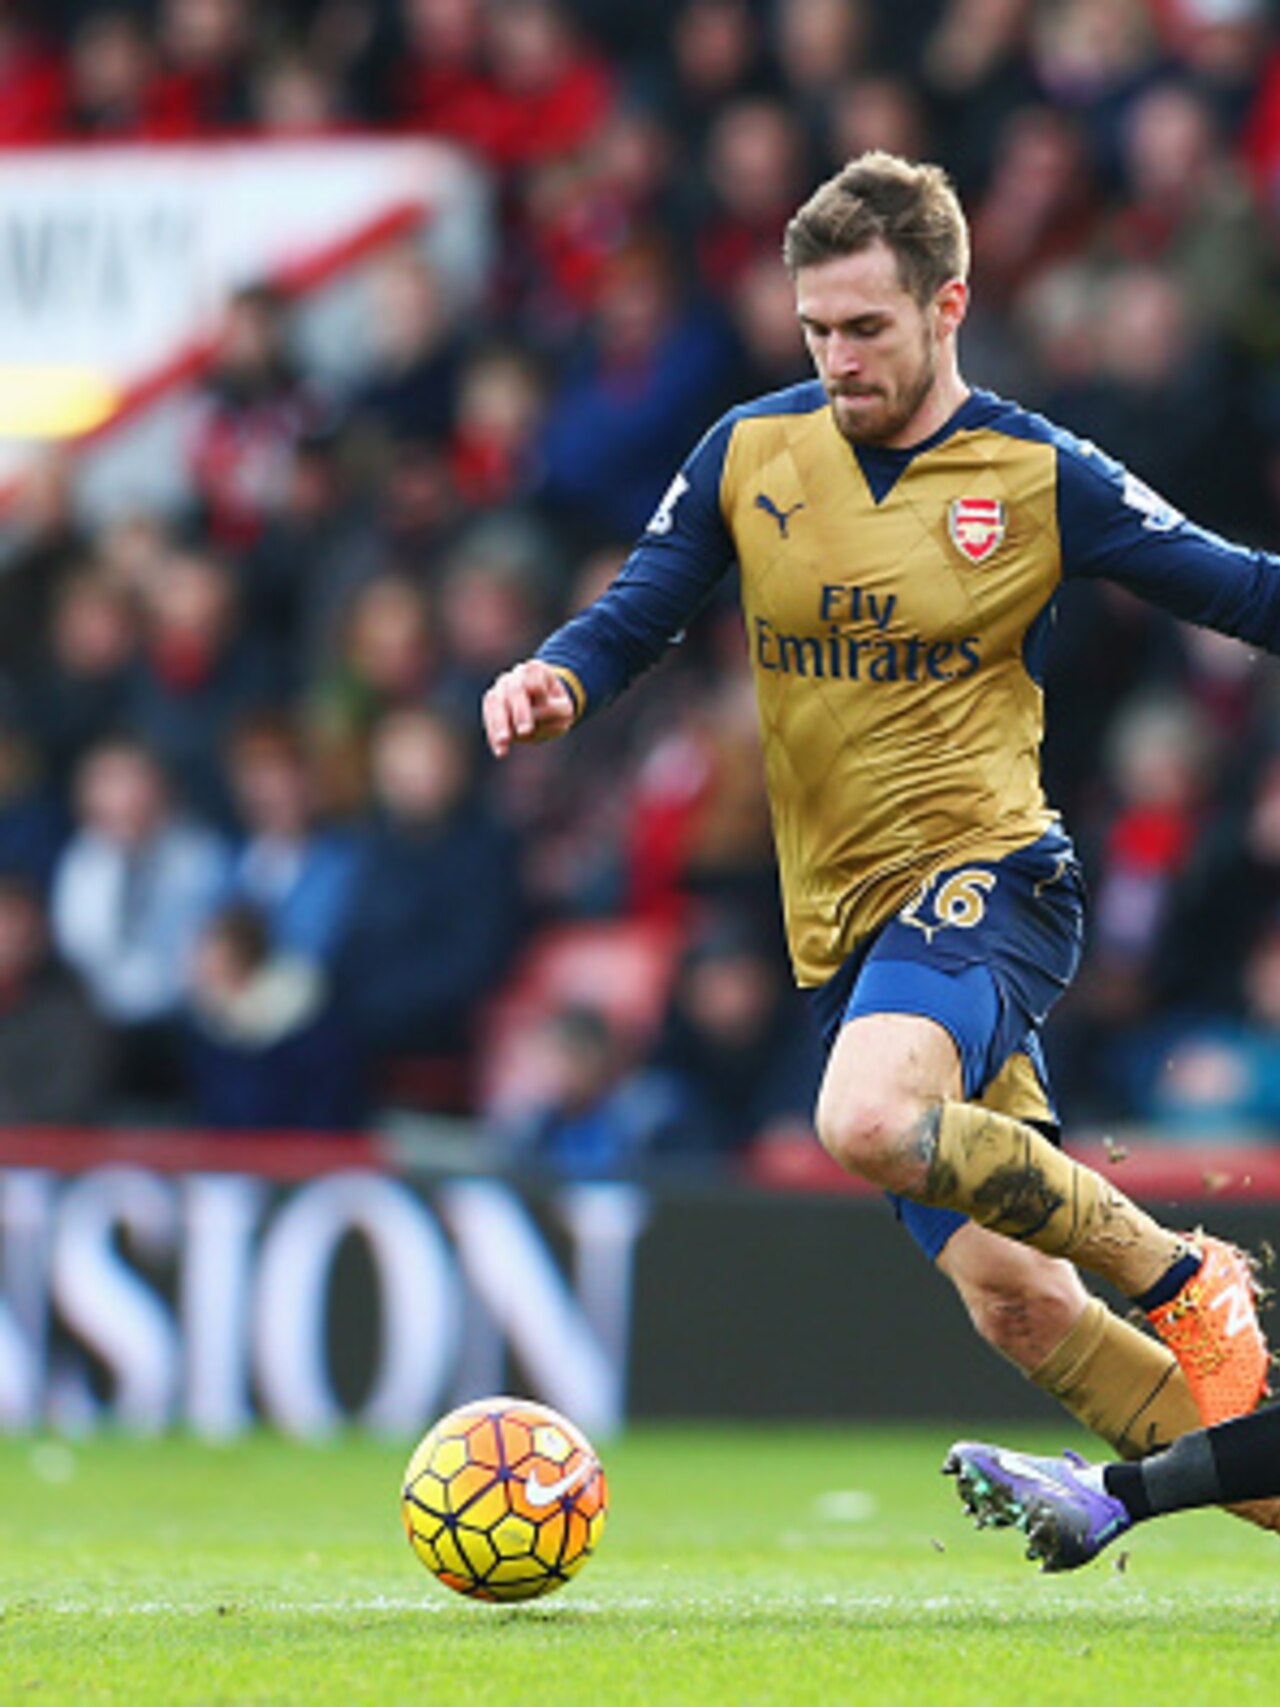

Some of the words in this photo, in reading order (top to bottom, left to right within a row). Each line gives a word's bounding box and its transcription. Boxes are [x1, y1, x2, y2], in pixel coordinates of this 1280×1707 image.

[819, 585, 897, 630] Fly
[755, 616, 981, 682] Emirates
[899, 869, 997, 929] 6
[0, 1164, 648, 1446] SION
